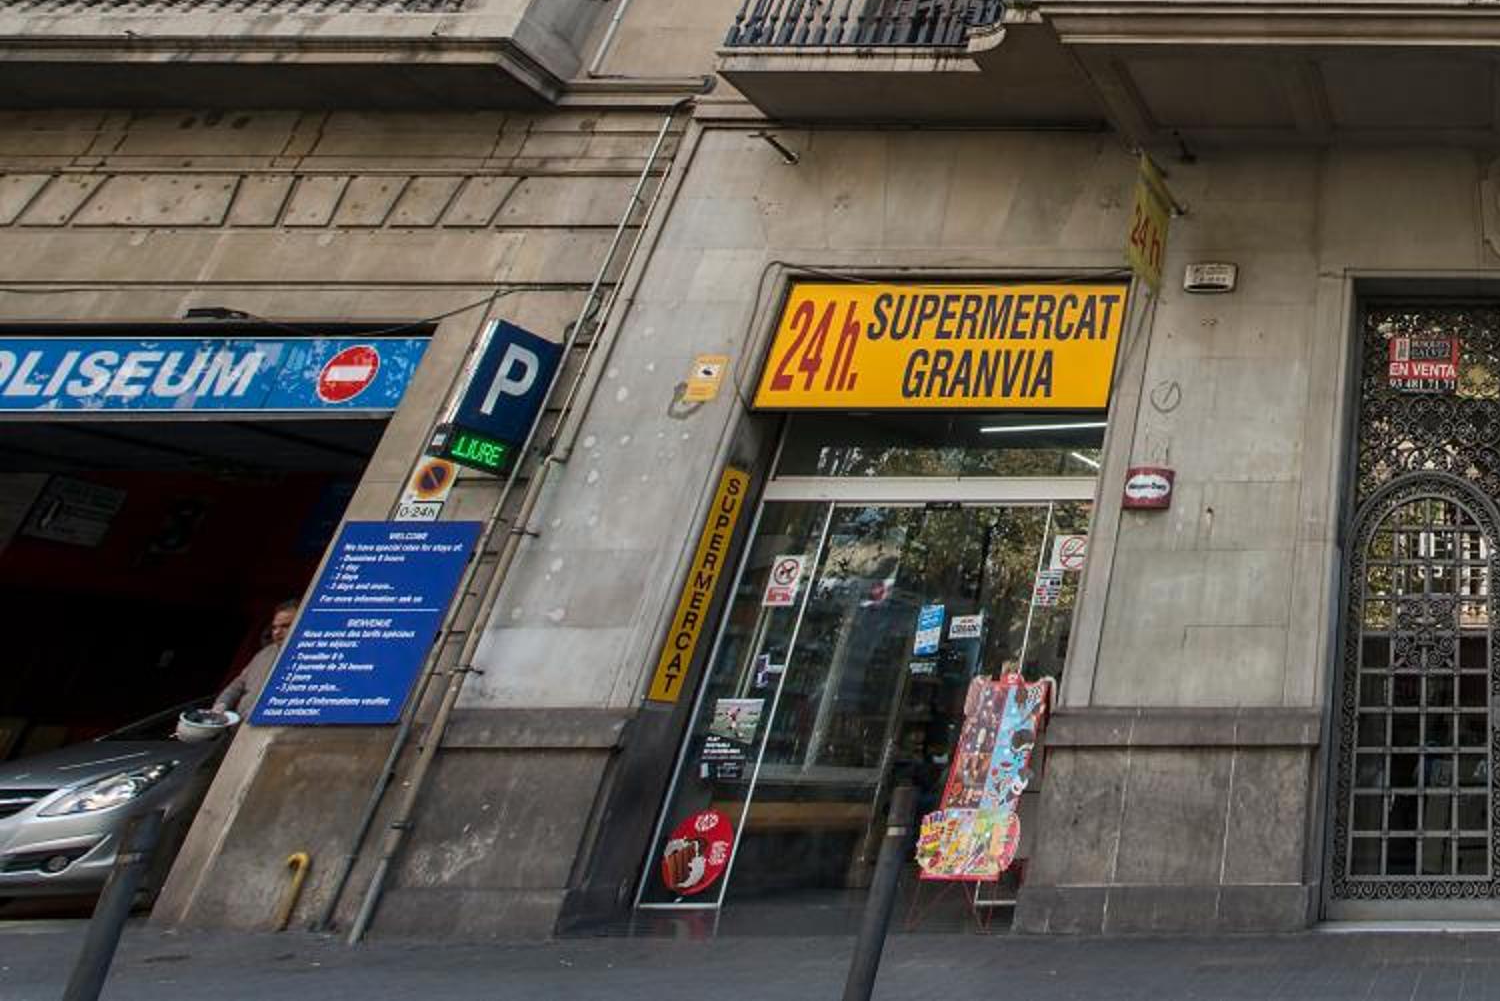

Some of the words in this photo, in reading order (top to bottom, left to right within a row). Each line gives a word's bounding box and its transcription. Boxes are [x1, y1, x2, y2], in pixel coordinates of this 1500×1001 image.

[867, 293, 1120, 341] SUPERMERCAT
[769, 299, 837, 392] 24
[1390, 363, 1409, 377] EN
[1412, 363, 1457, 377] VENTA
[0, 350, 265, 397] LISEUM
[480, 342, 540, 415] P
[901, 349, 1053, 398] GRANVIA
[664, 479, 741, 694] SUPERMERCAT
